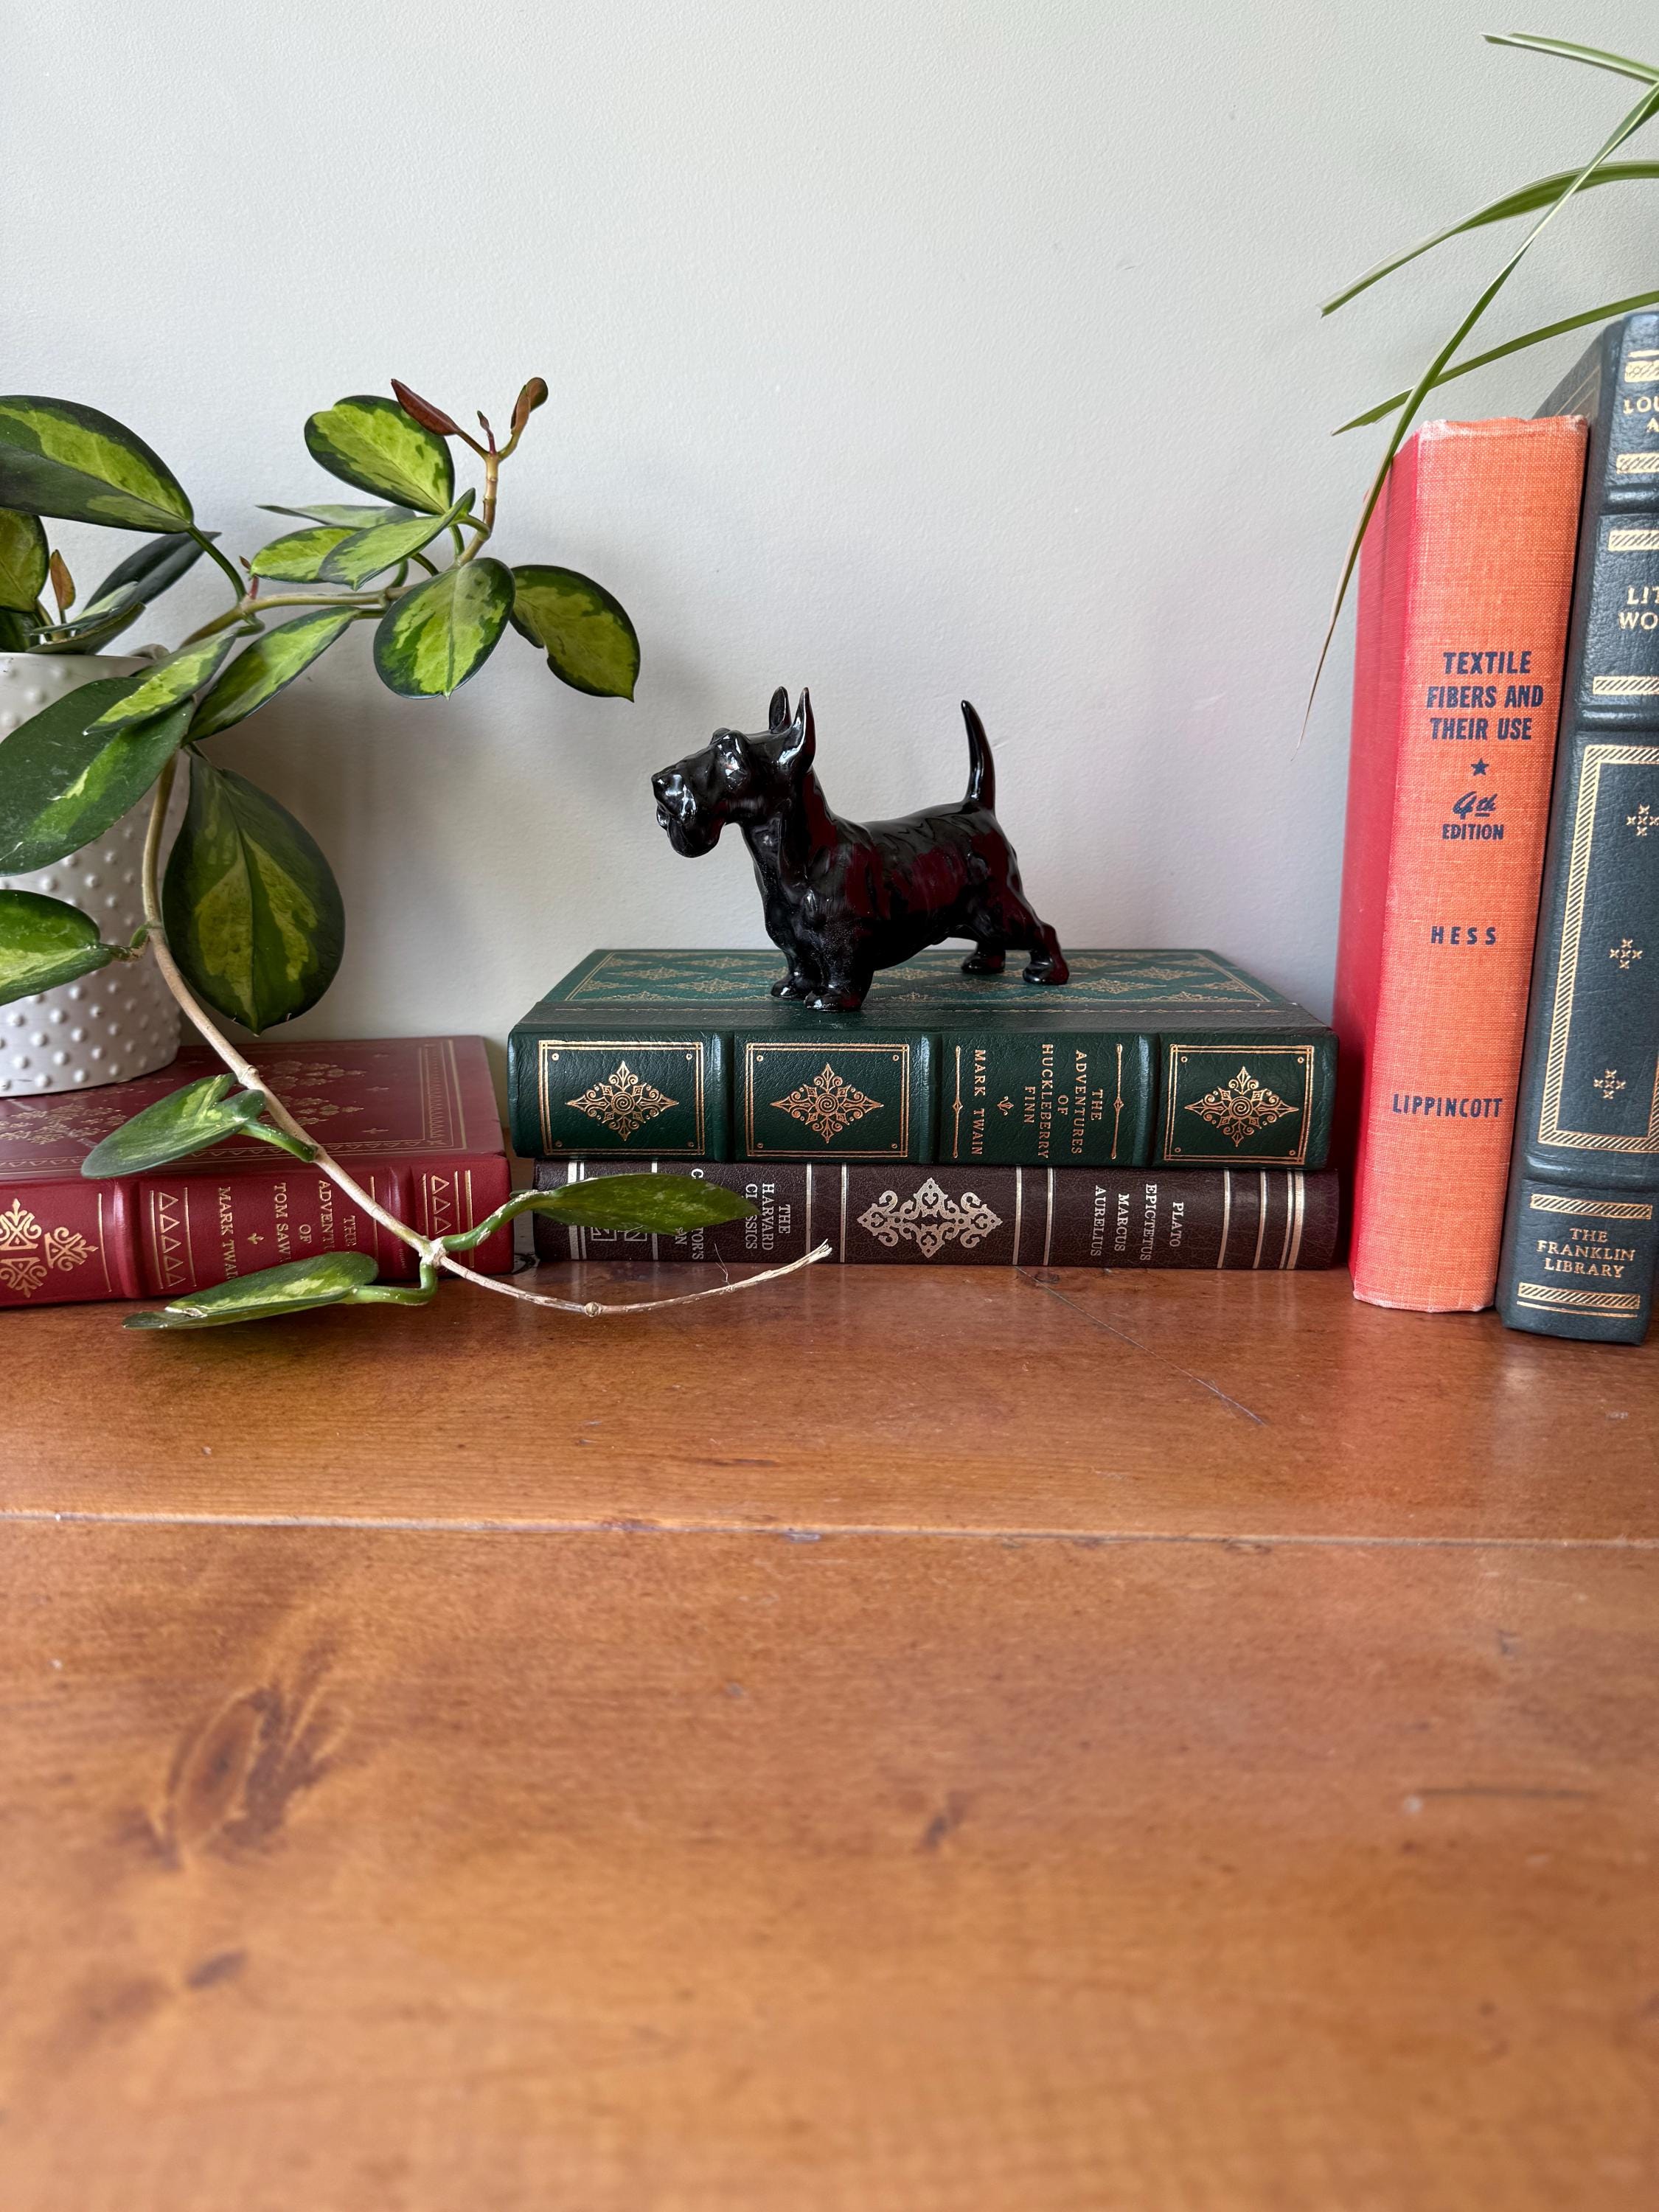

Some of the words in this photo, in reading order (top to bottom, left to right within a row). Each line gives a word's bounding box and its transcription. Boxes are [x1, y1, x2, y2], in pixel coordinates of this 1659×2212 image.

[1443, 651, 1531, 675] TEXTILE
[1427, 686, 1497, 709] FIBERS
[1504, 685, 1543, 708] AND
[1429, 717, 1489, 740] THEIR
[1497, 717, 1532, 740] USE
[1453, 790, 1498, 819] 4th
[1441, 824, 1504, 840] EDITION
[1431, 926, 1496, 945] HESS
[974, 1049, 986, 1096] MARK
[1023, 1086, 1036, 1123] FINN
[1037, 1043, 1054, 1158] HUCKLEBERRY
[1057, 1094, 1068, 1115] OF
[1071, 1049, 1088, 1155] ADVENTURES
[1091, 1089, 1103, 1121] THE
[1393, 1093, 1503, 1118] LIPPINCOTT
[971, 1107, 985, 1155] TWAIN
[218, 1186, 234, 1236] MARK
[274, 1182, 288, 1218] TOM
[745, 1183, 758, 1249] CLSSICS
[344, 1215, 357, 1246] THE
[762, 1183, 775, 1251] HARVARD
[779, 1204, 791, 1234] THE
[1090, 1185, 1106, 1256] AURELIUS
[1114, 1193, 1130, 1251] MARCUS
[1140, 1183, 1157, 1261] EPICTETUS
[1169, 1201, 1184, 1248] PLATO
[299, 1224, 312, 1244] OF
[1569, 1228, 1608, 1243] THE
[222, 1239, 238, 1279] TWAI
[1536, 1240, 1635, 1261] FRANKLIN
[1544, 1258, 1624, 1278] LIBRARY
